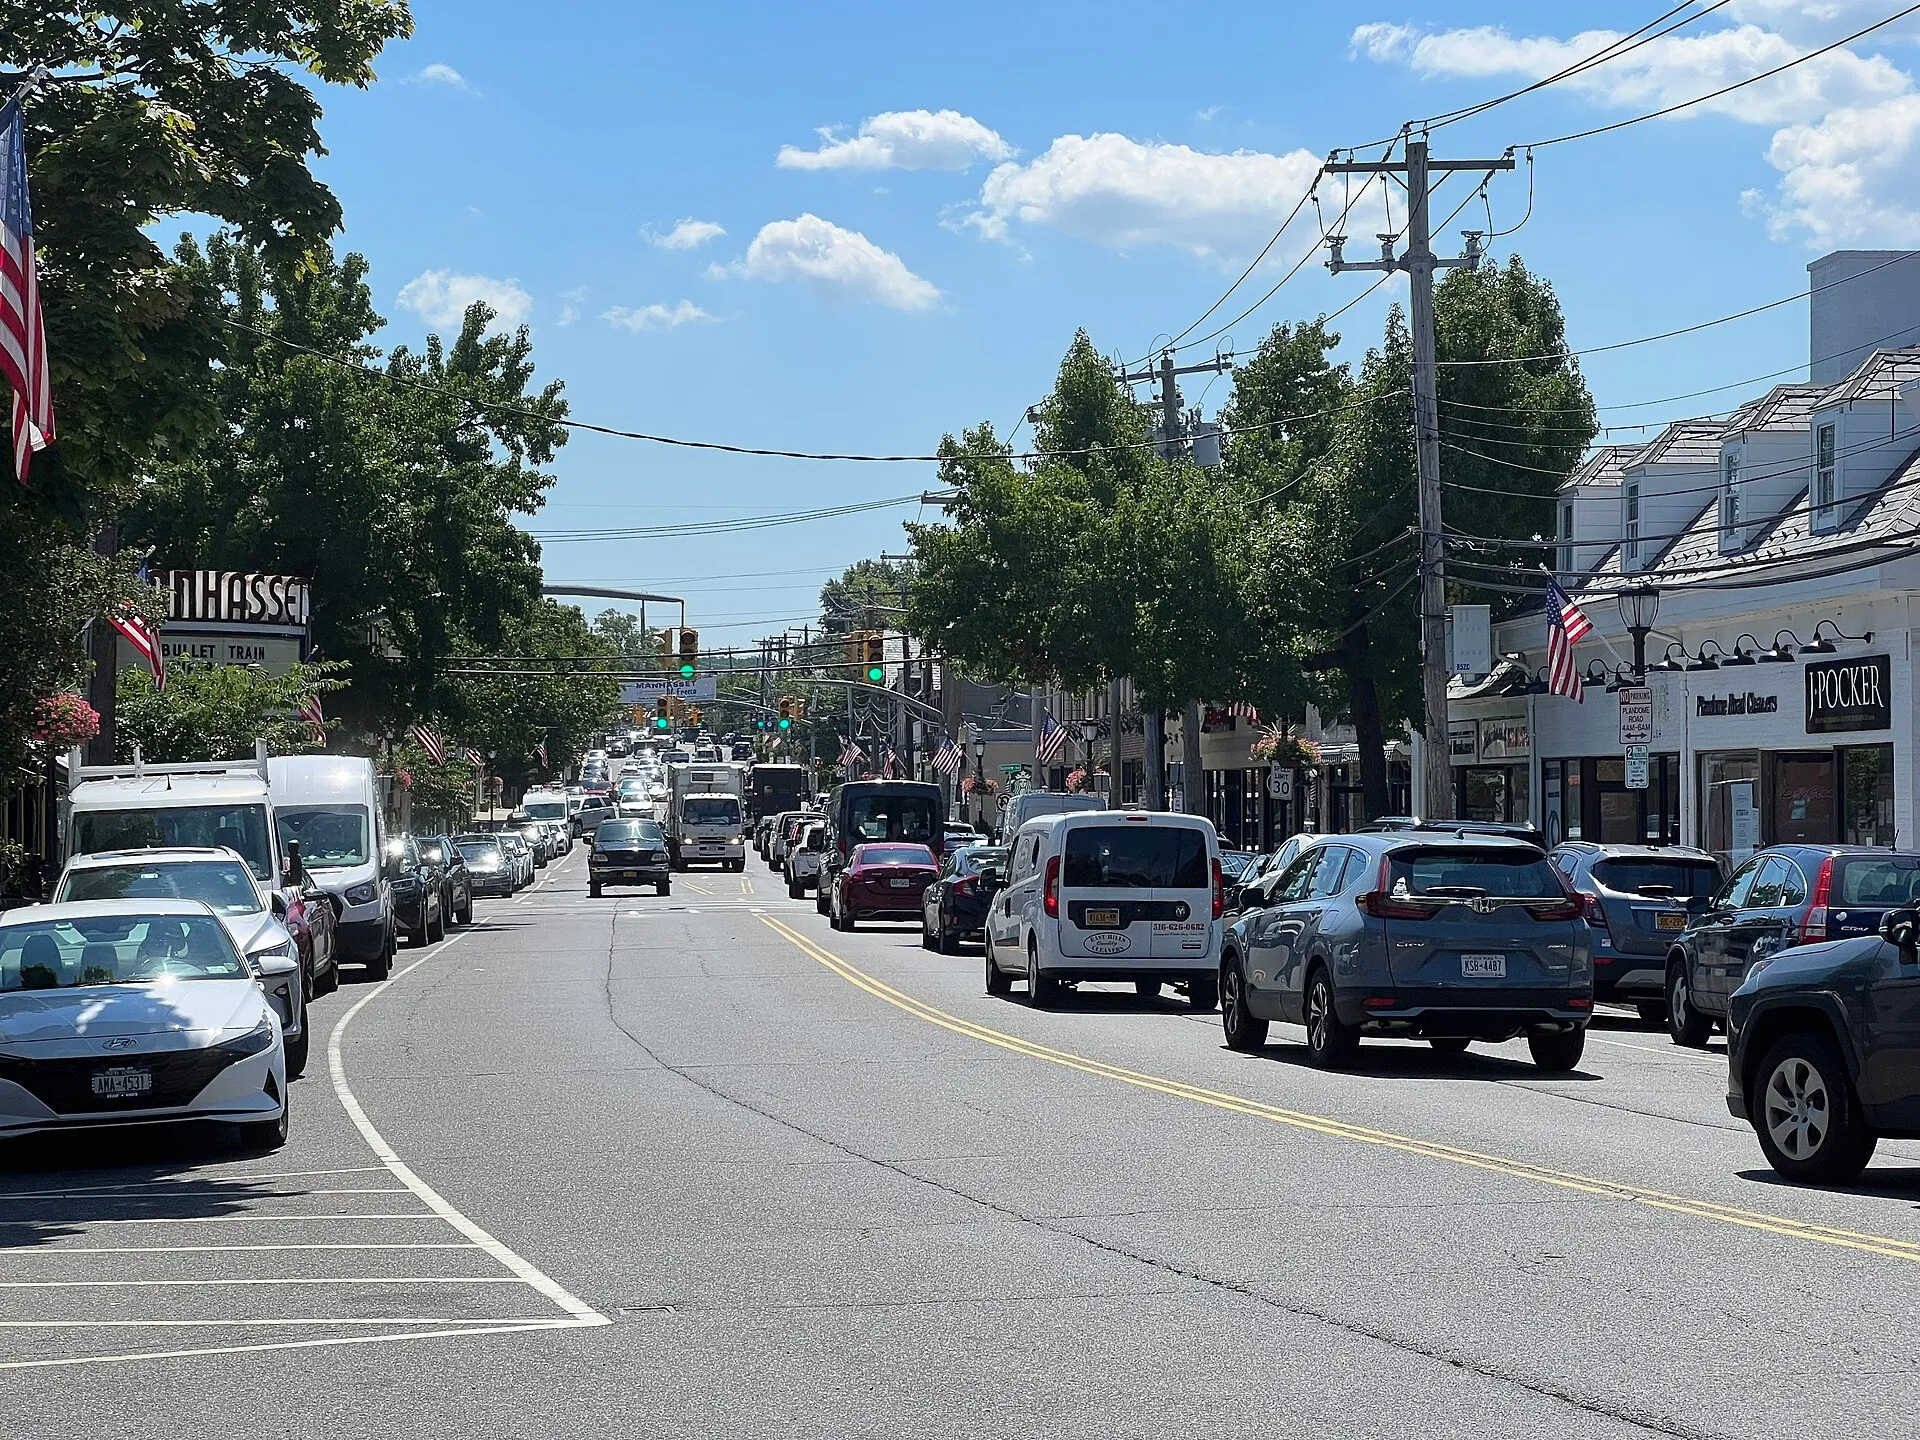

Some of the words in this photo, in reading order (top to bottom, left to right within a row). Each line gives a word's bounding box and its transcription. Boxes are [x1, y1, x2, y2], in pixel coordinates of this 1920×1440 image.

[162, 643, 216, 659] BULLET
[228, 645, 265, 661] TRAIN
[636, 680, 697, 689] MANHASSET
[1621, 689, 1629, 703] NO
[1630, 692, 1650, 700] PARKING
[1627, 747, 1633, 758] 2
[1273, 781, 1290, 795] 30
